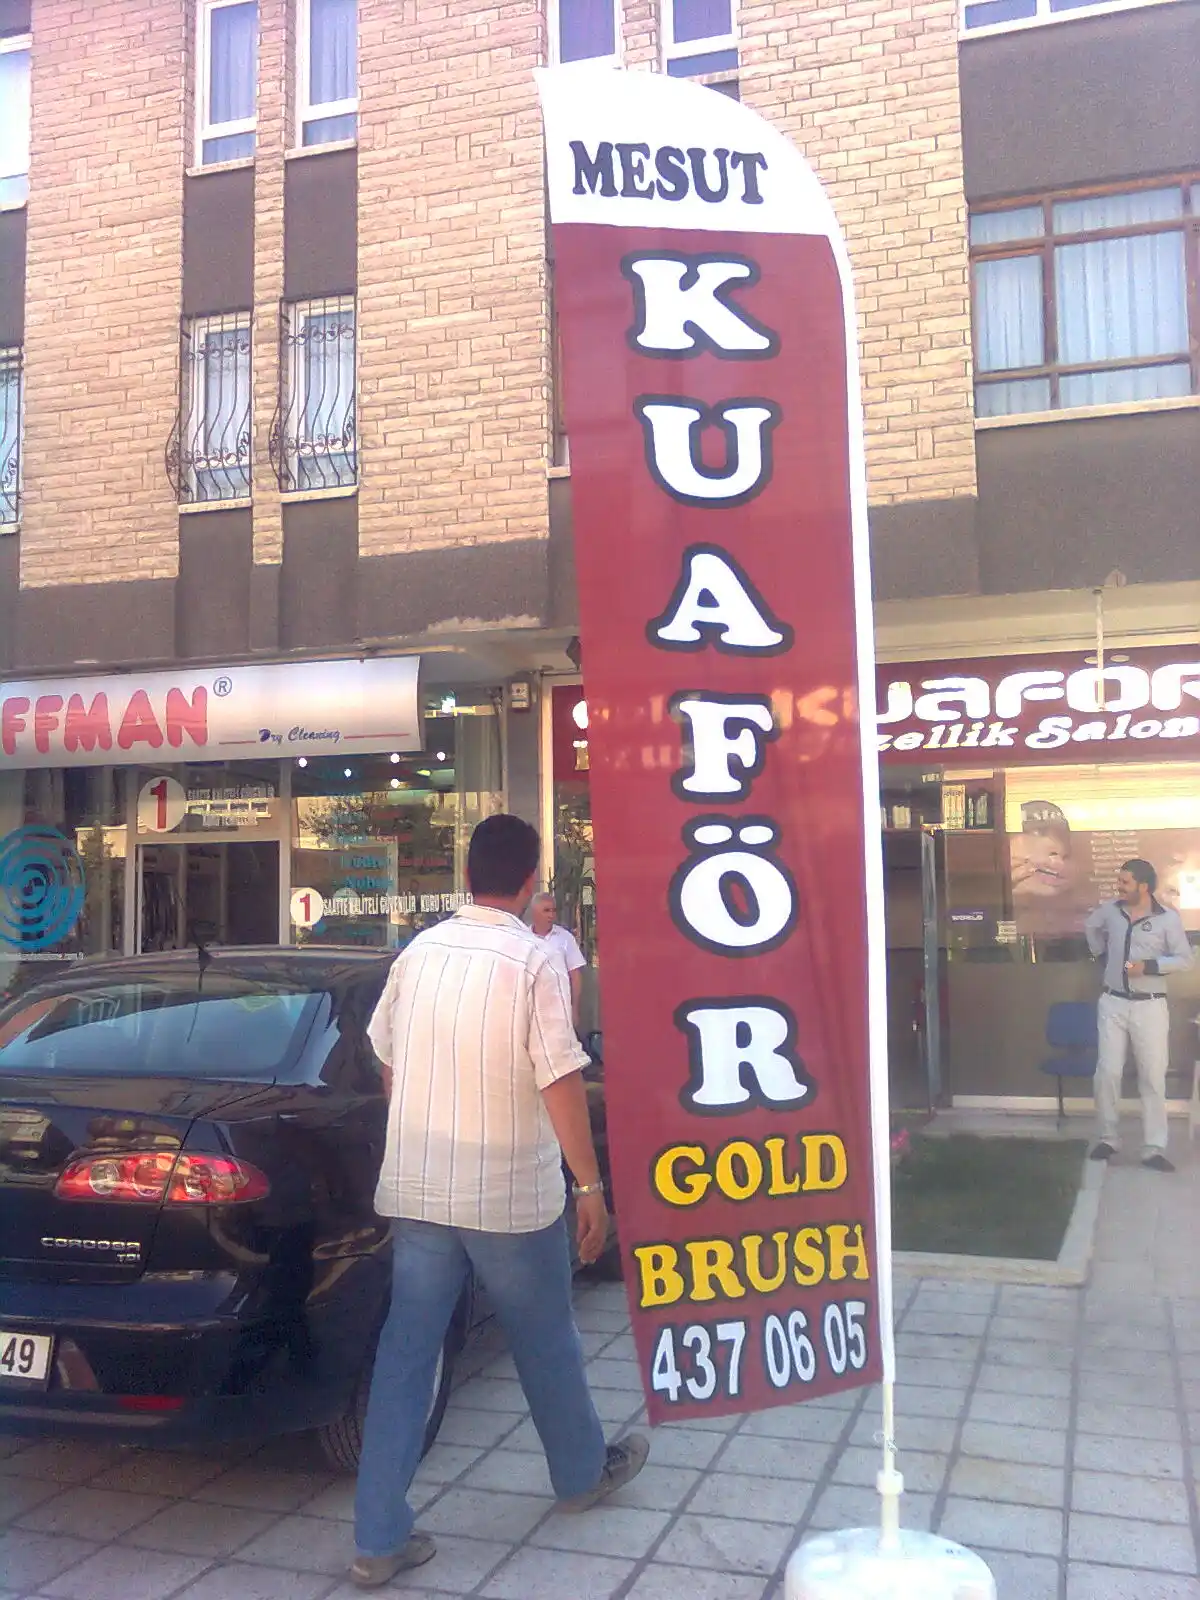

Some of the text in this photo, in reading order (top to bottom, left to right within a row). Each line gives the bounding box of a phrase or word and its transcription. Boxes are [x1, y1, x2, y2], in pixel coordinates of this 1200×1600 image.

[568, 140, 768, 205] MESUT
[2, 686, 208, 755] FFMAN
[259, 726, 341, 744] Dry Cleaning
[151, 779, 167, 829] 1
[299, 893, 311, 922] 1
[654, 1133, 848, 1206] GOLD
[634, 1224, 870, 1308] BRUSH
[1, 1336, 36, 1374] 49
[652, 1300, 866, 1401] 437 06 05
